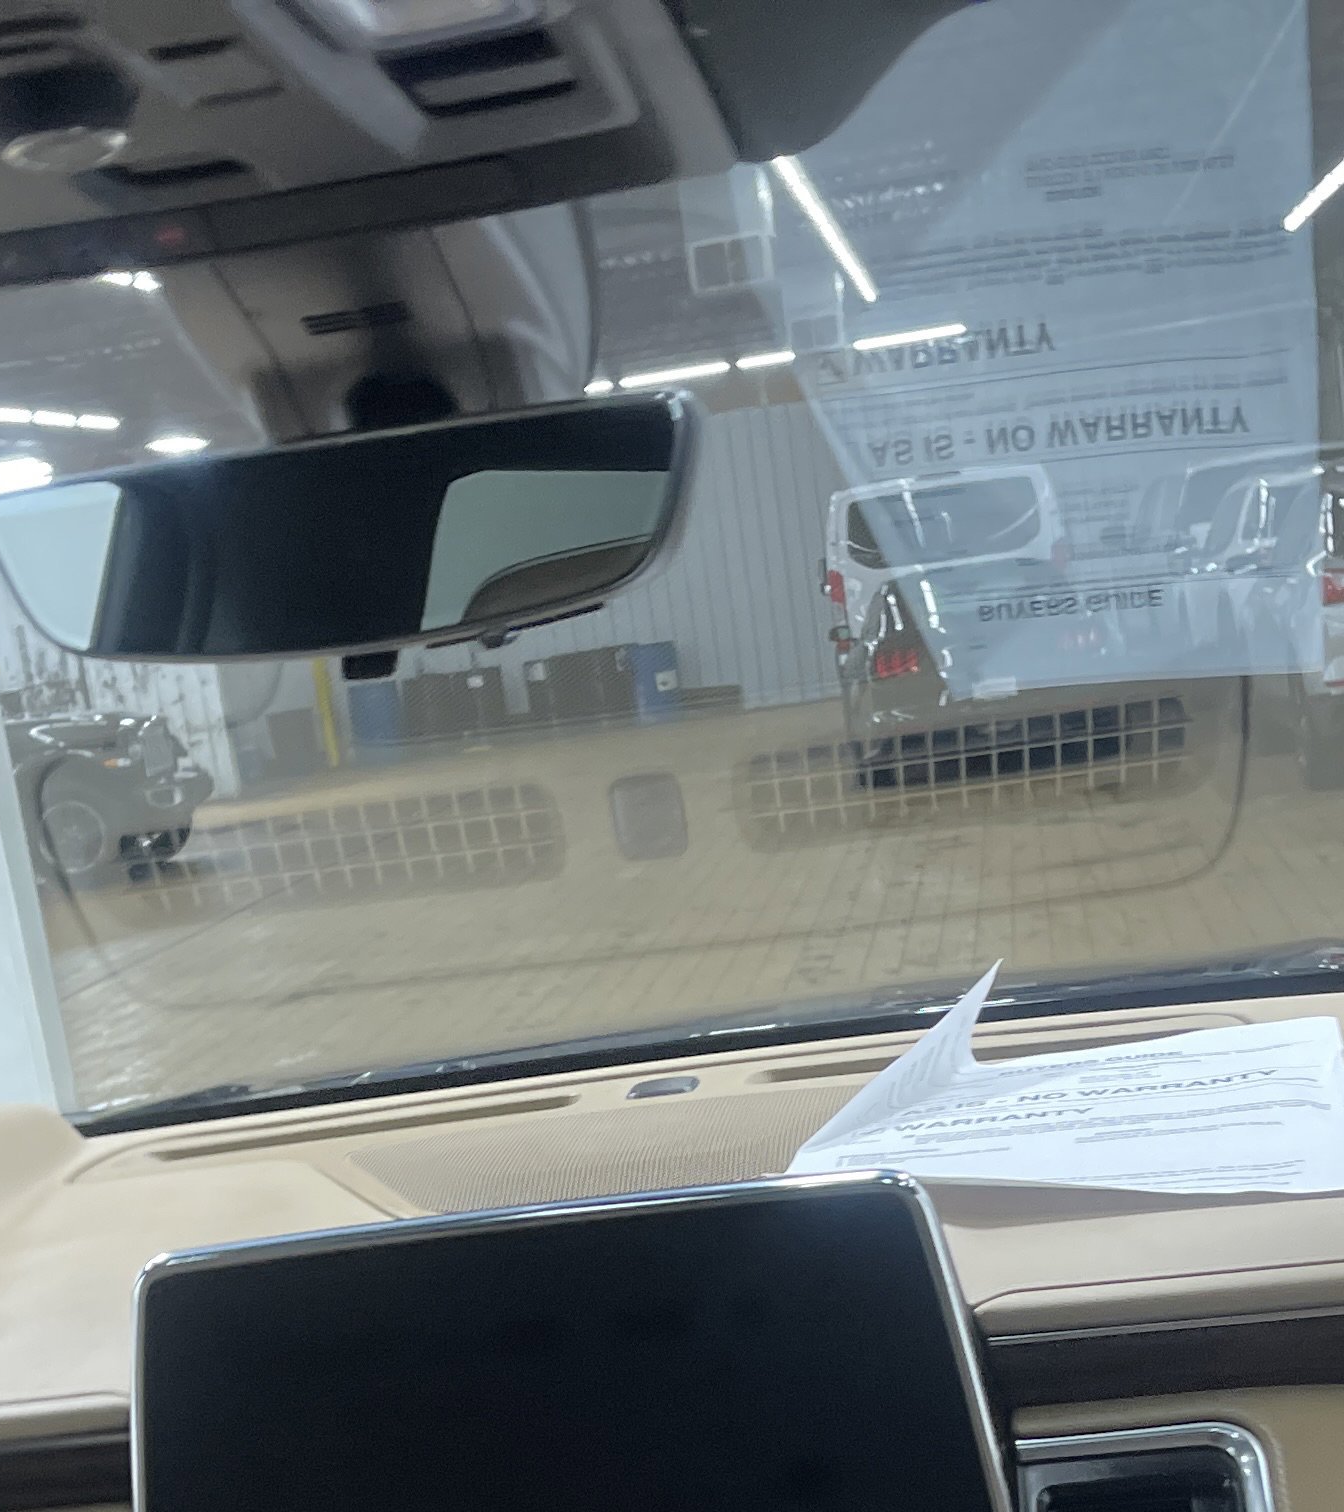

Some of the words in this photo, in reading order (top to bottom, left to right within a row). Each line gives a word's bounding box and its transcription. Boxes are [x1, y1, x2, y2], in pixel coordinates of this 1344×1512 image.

[1017, 1092, 1068, 1103] NO
[1077, 1069, 1277, 1097] WARRANTY
[893, 1107, 1094, 1132] WARRANTY
